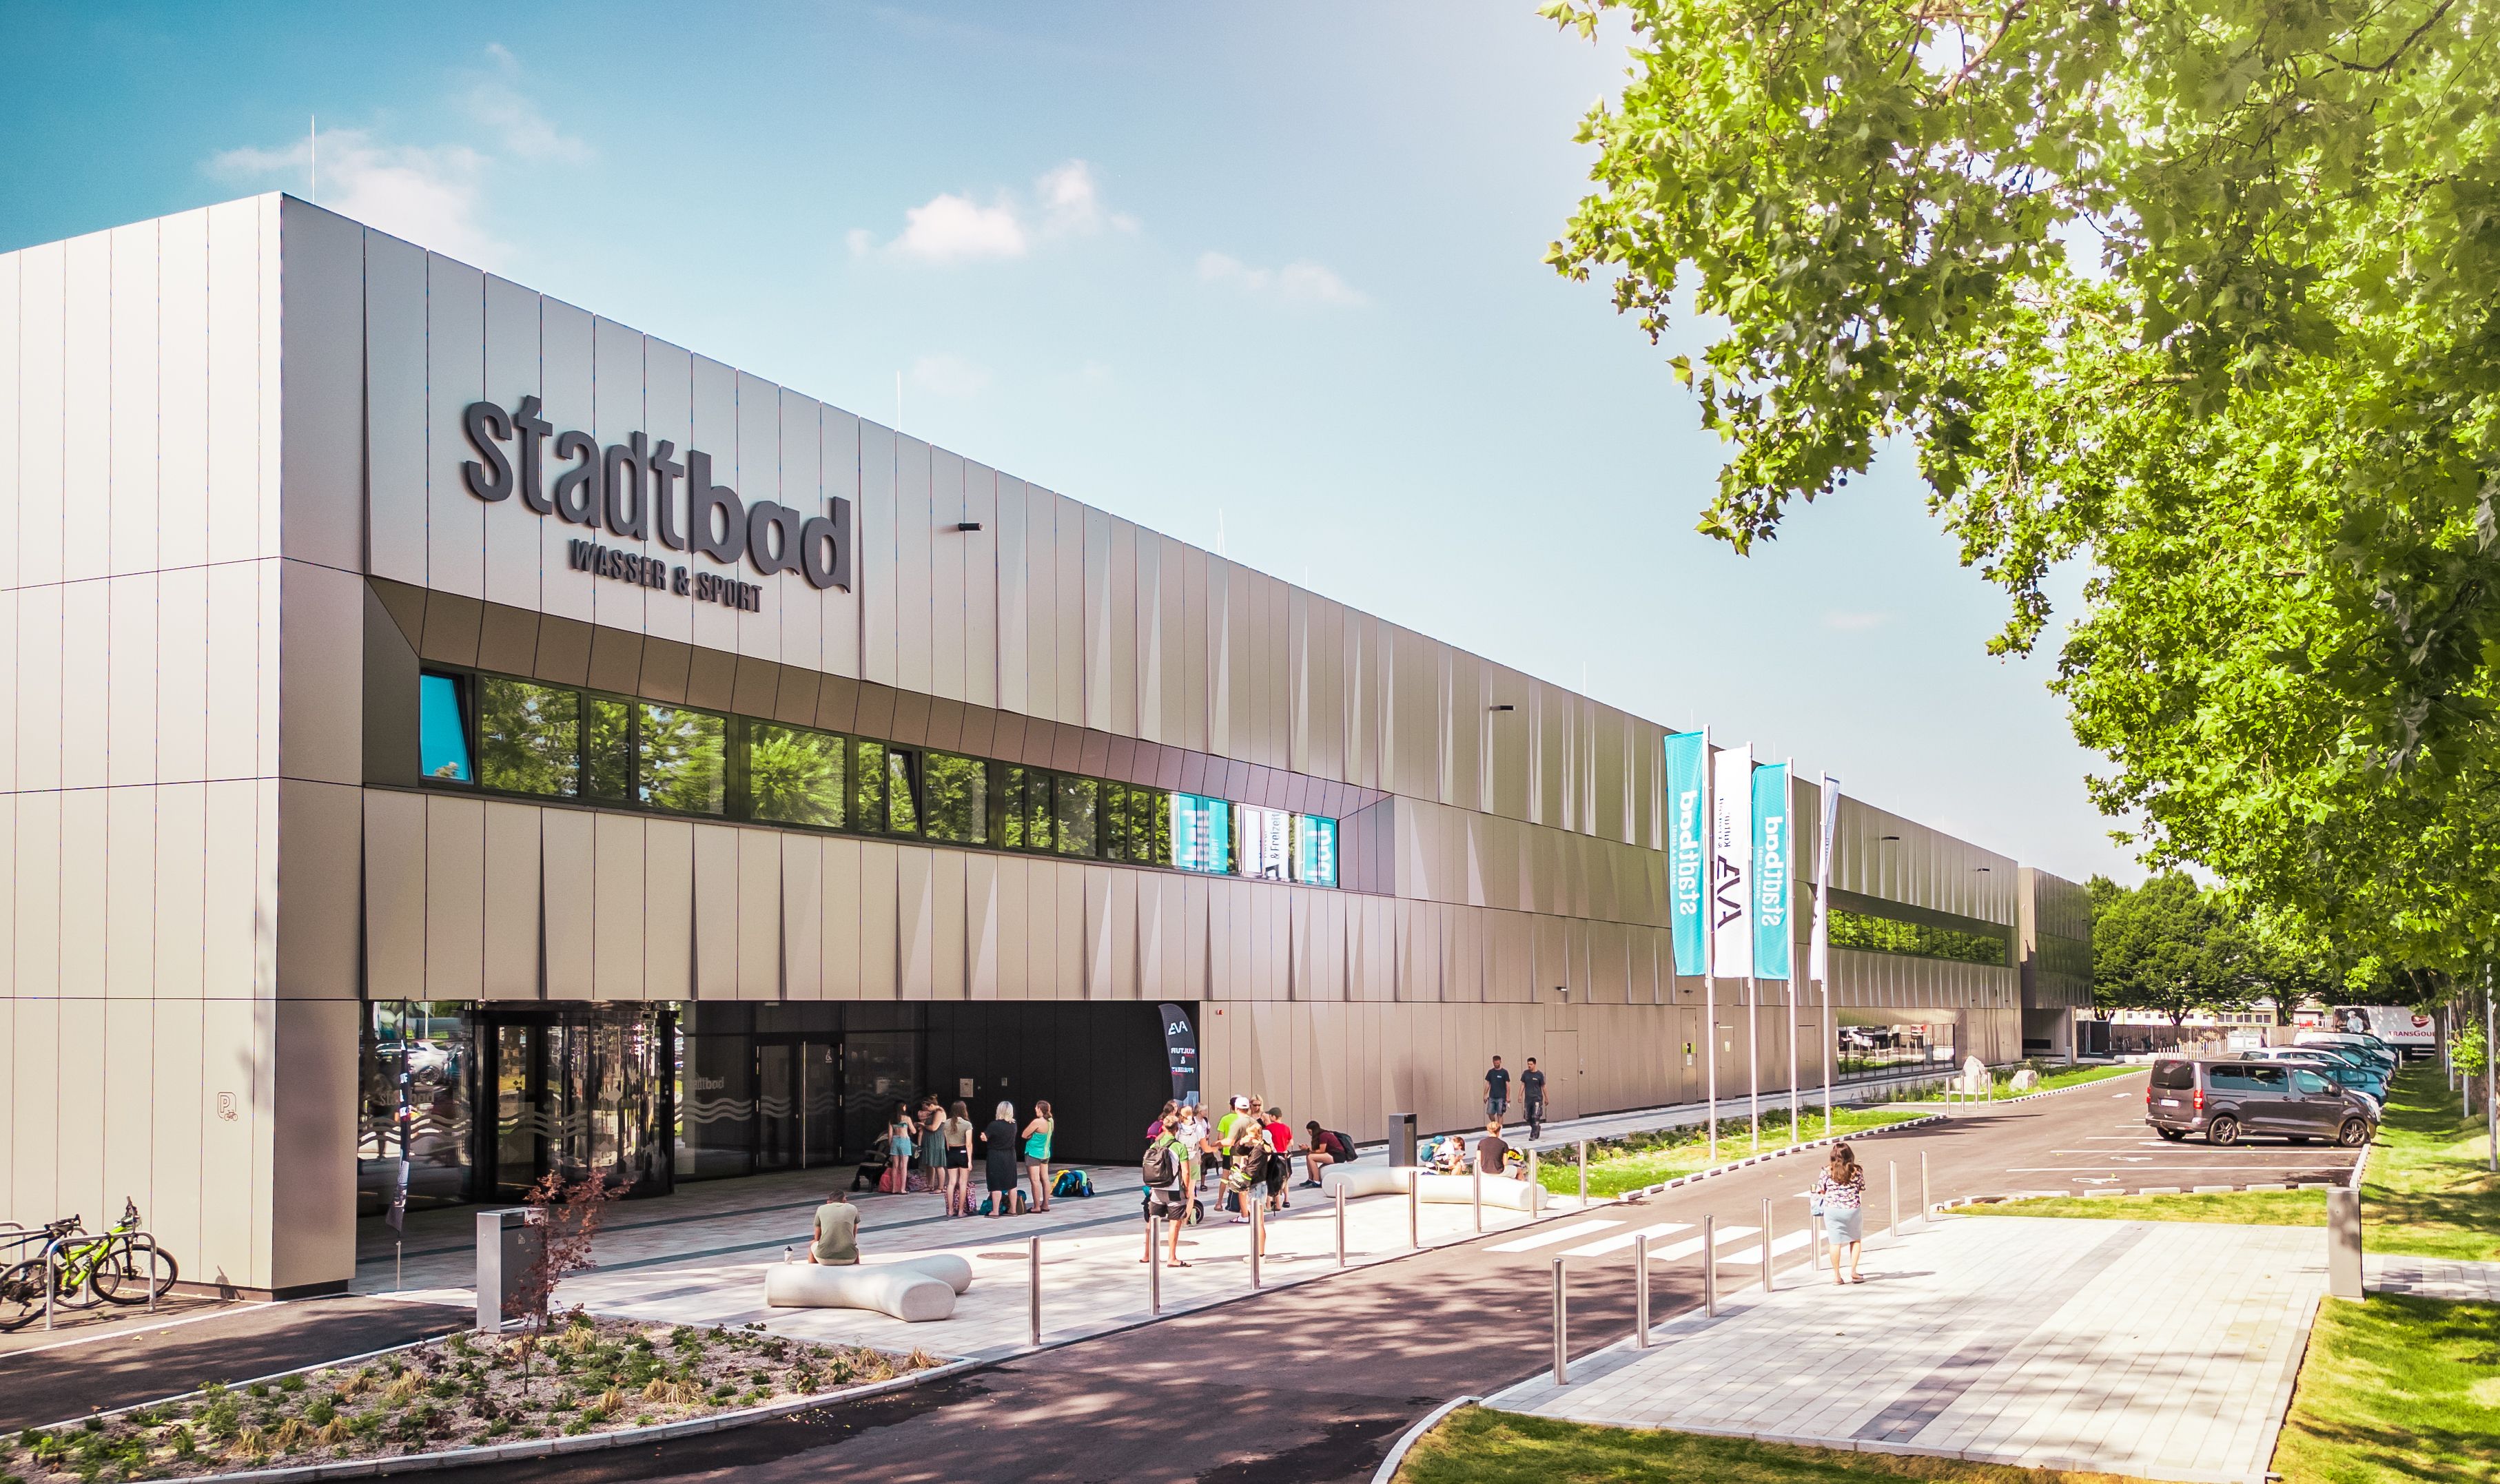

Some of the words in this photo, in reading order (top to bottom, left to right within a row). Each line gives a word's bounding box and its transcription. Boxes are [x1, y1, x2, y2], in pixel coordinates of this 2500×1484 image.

[466, 395, 851, 594] stadtbad
[569, 539, 666, 591] WASSER
[673, 566, 690, 596] &
[696, 572, 764, 613] SPORT
[1270, 813, 1280, 852] Freizeit
[220, 1095, 230, 1113] P
